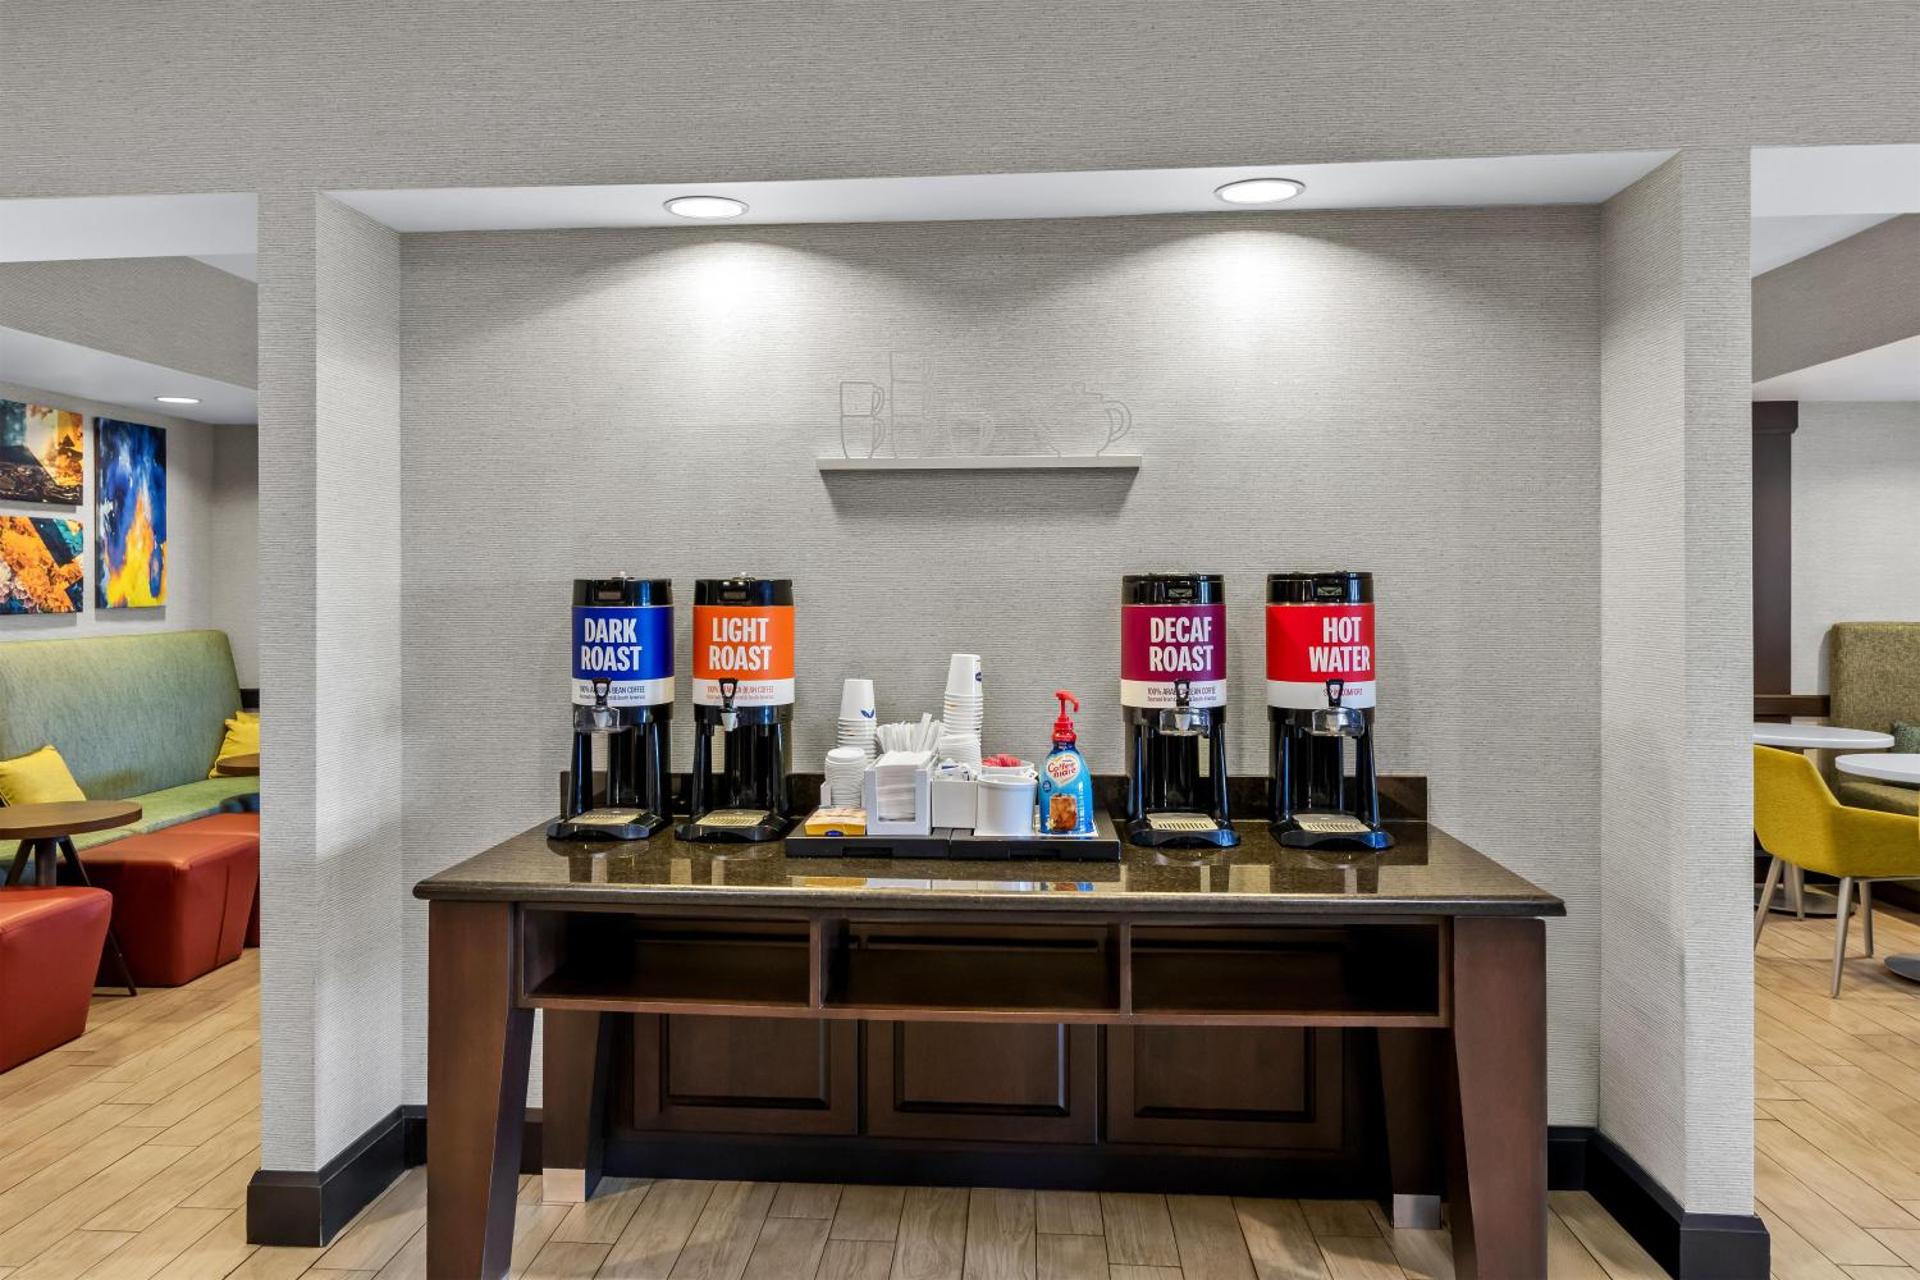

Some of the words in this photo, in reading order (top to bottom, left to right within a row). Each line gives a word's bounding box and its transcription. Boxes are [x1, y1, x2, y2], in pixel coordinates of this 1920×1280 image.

[584, 617, 637, 643] DARK
[712, 617, 769, 643] LIGHT
[1150, 616, 1212, 643] DECAF
[1323, 616, 1362, 643] HOT
[581, 645, 642, 671] ROAST
[708, 645, 772, 671] ROAST
[1149, 645, 1214, 672] ROAST
[1308, 645, 1370, 672] WATER
